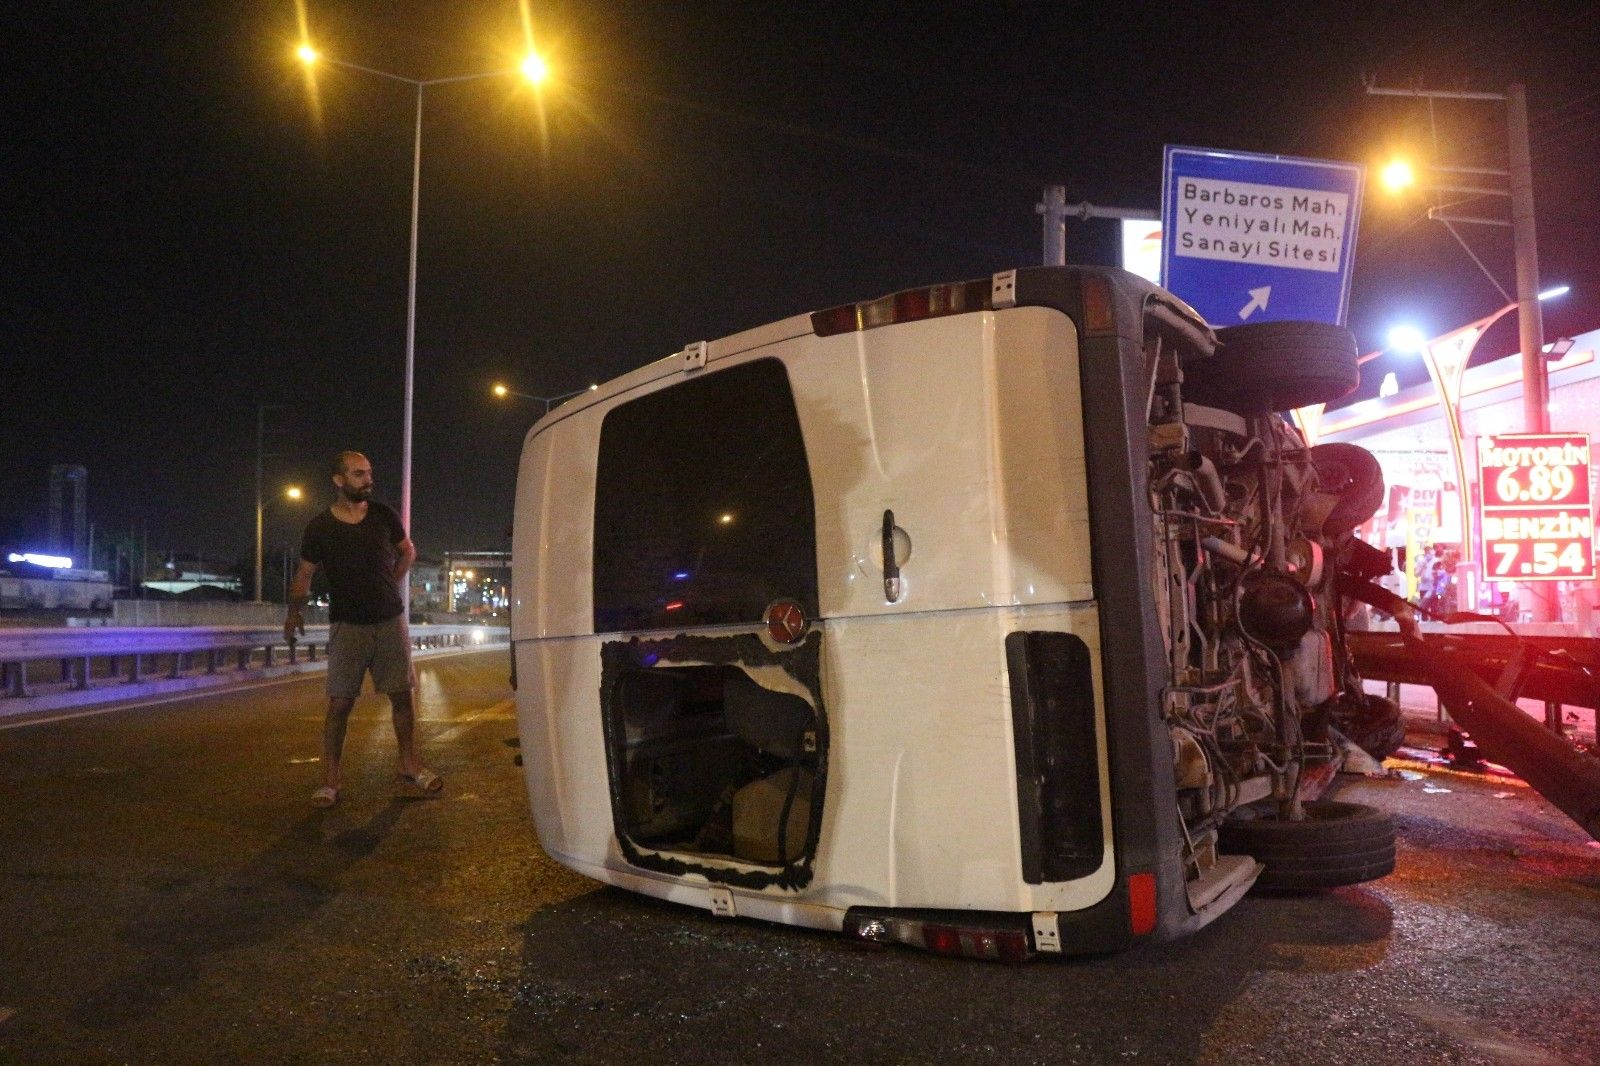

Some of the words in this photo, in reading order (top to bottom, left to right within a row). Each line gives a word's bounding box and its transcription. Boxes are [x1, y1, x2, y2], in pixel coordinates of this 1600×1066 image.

[1184, 183, 1284, 210] Barbaros
[1184, 208, 1286, 235] Yeniyalı
[1182, 232, 1261, 258] Sanayi
[1268, 241, 1337, 263] Sitesi
[1496, 465, 1574, 502] 6.89
[1485, 511, 1591, 540] BENZİN
[1493, 542, 1585, 575] 7.54
